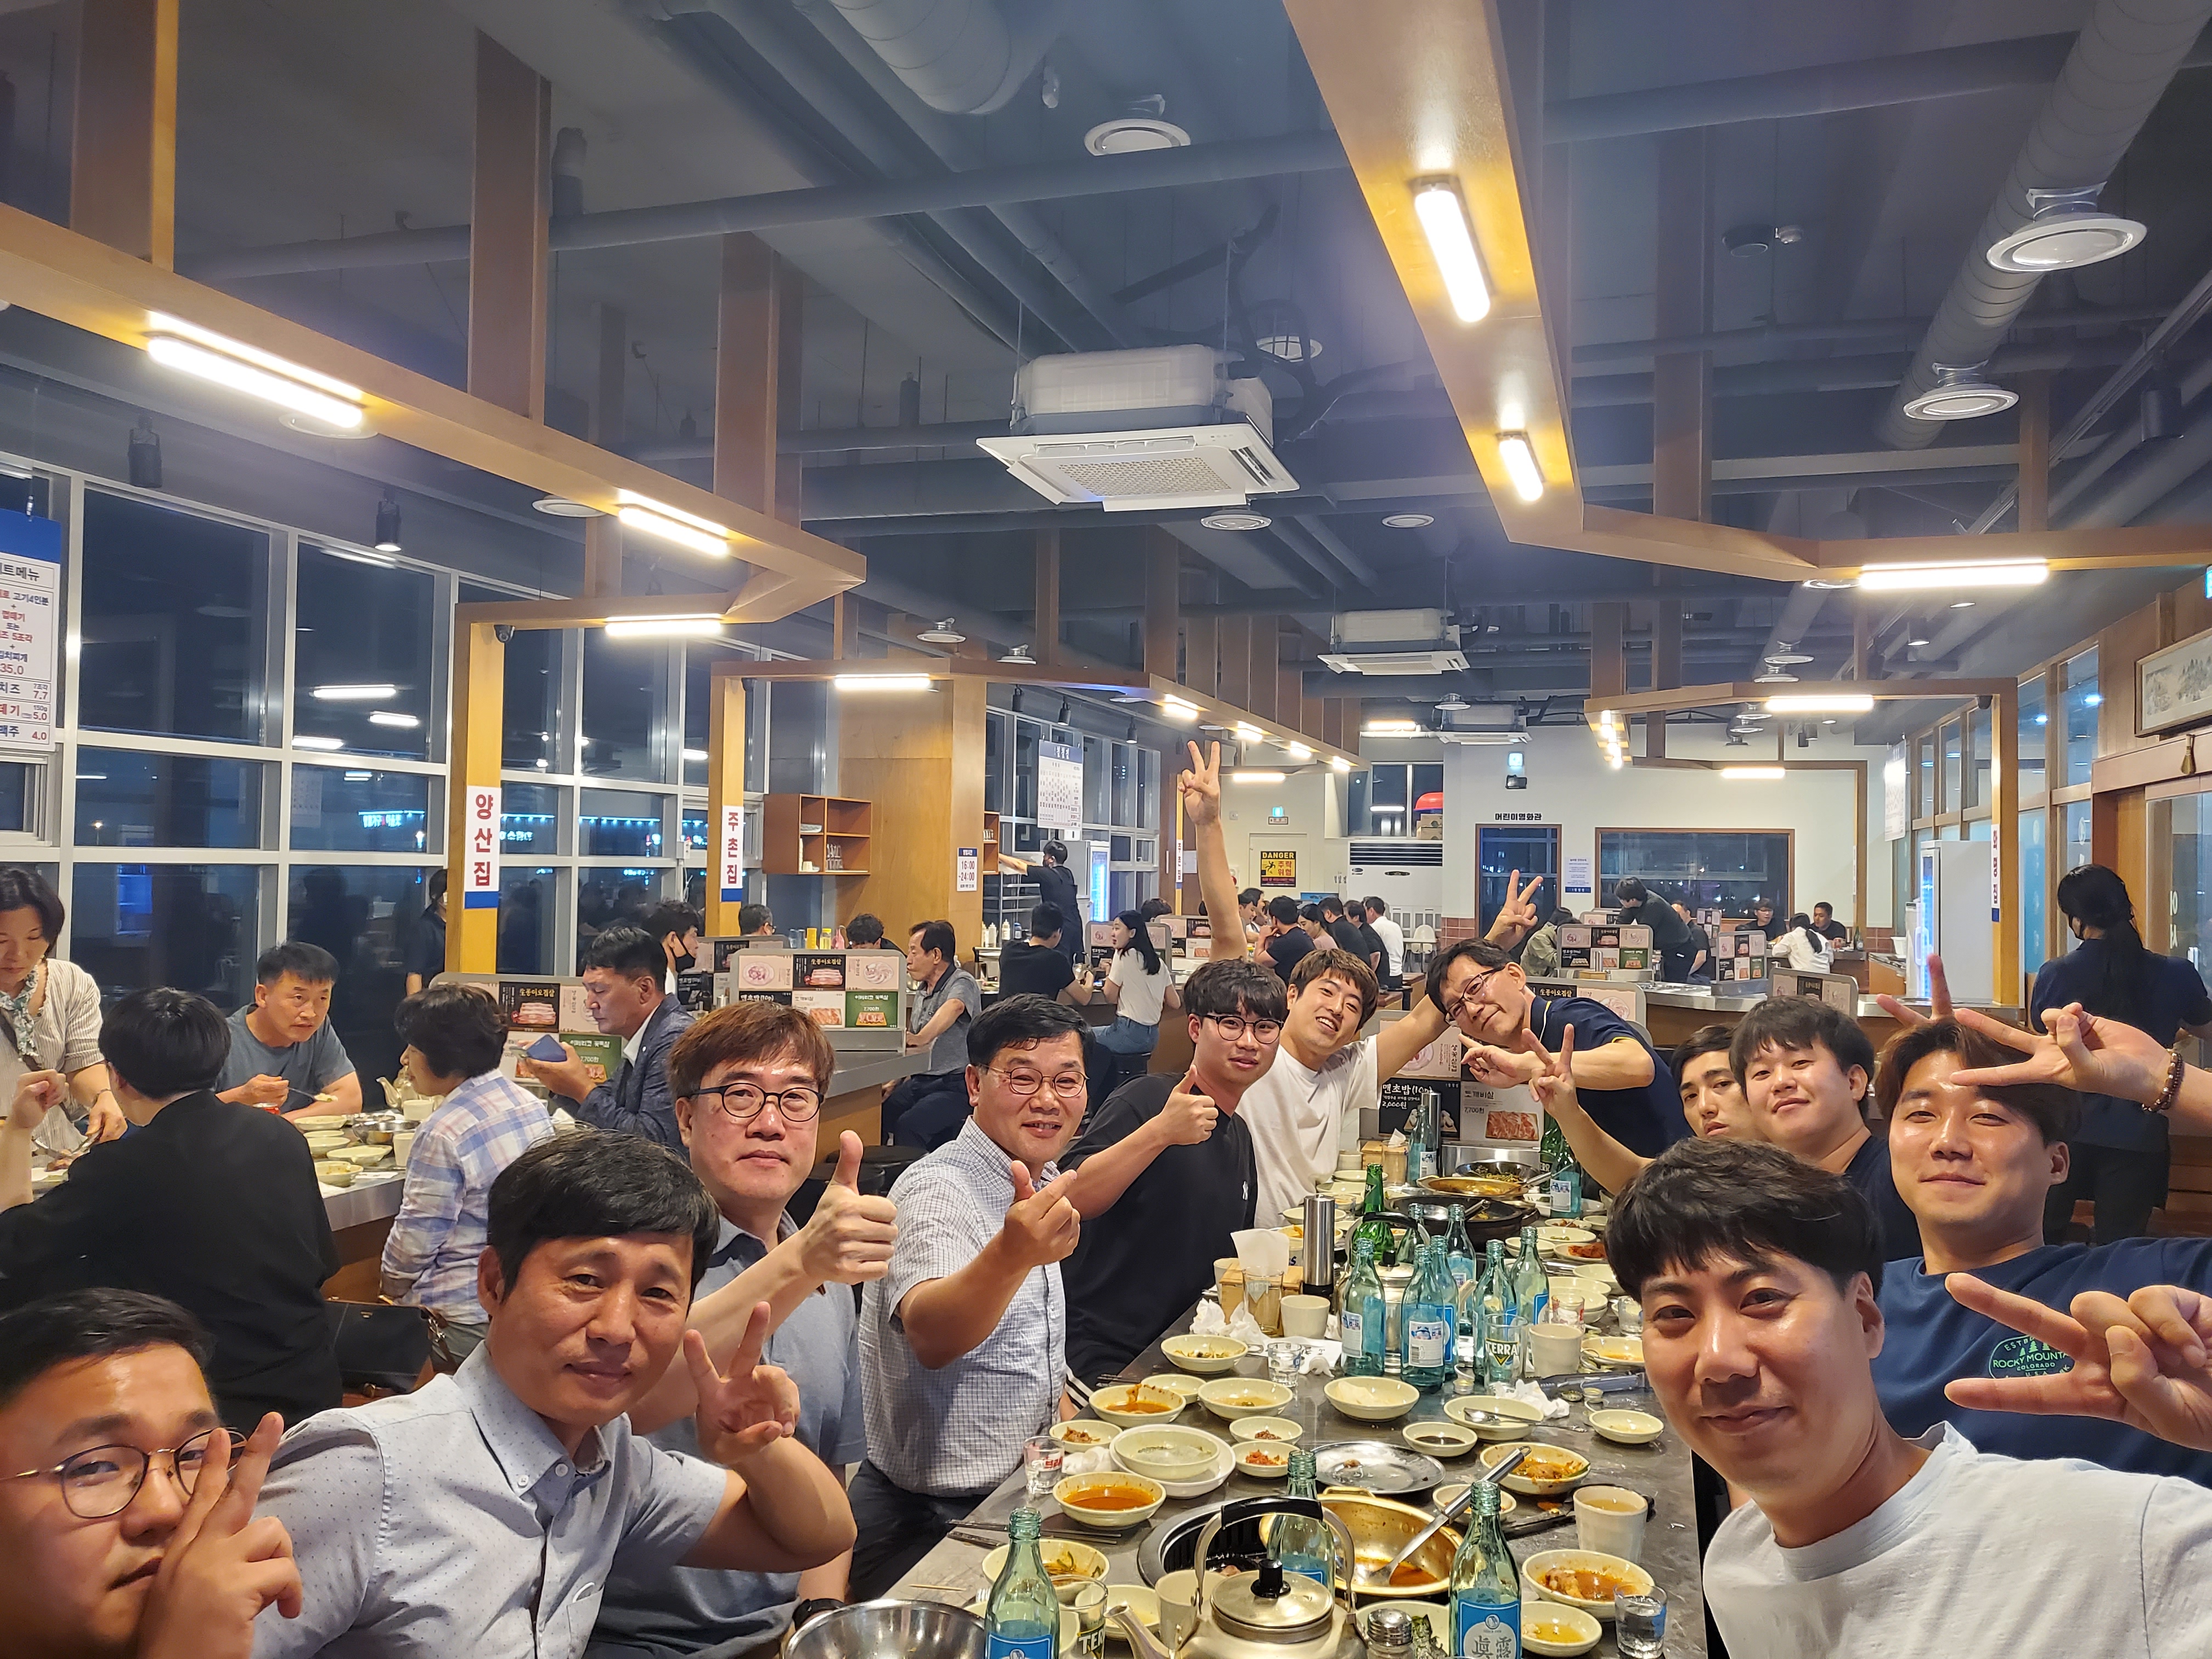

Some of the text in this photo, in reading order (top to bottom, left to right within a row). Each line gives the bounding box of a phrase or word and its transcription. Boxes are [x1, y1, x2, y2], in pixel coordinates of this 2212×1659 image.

[0, 562, 40, 582] 트메뉴
[0, 663, 24, 675] 35.0
[33, 690, 48, 700] 7.7
[33, 712, 48, 721] 5.0
[32, 731, 47, 741] 4.0
[473, 794, 493, 887] 양산집
[727, 811, 738, 884] 주촌집
[962, 860, 975, 870] 16:00
[1382, 1101, 1407, 1109] 2,000원
[1486, 1341, 1518, 1356] TERRA
[1993, 1357, 2025, 1368] ROCKY
[2017, 1362, 2055, 1371] COLORADO
